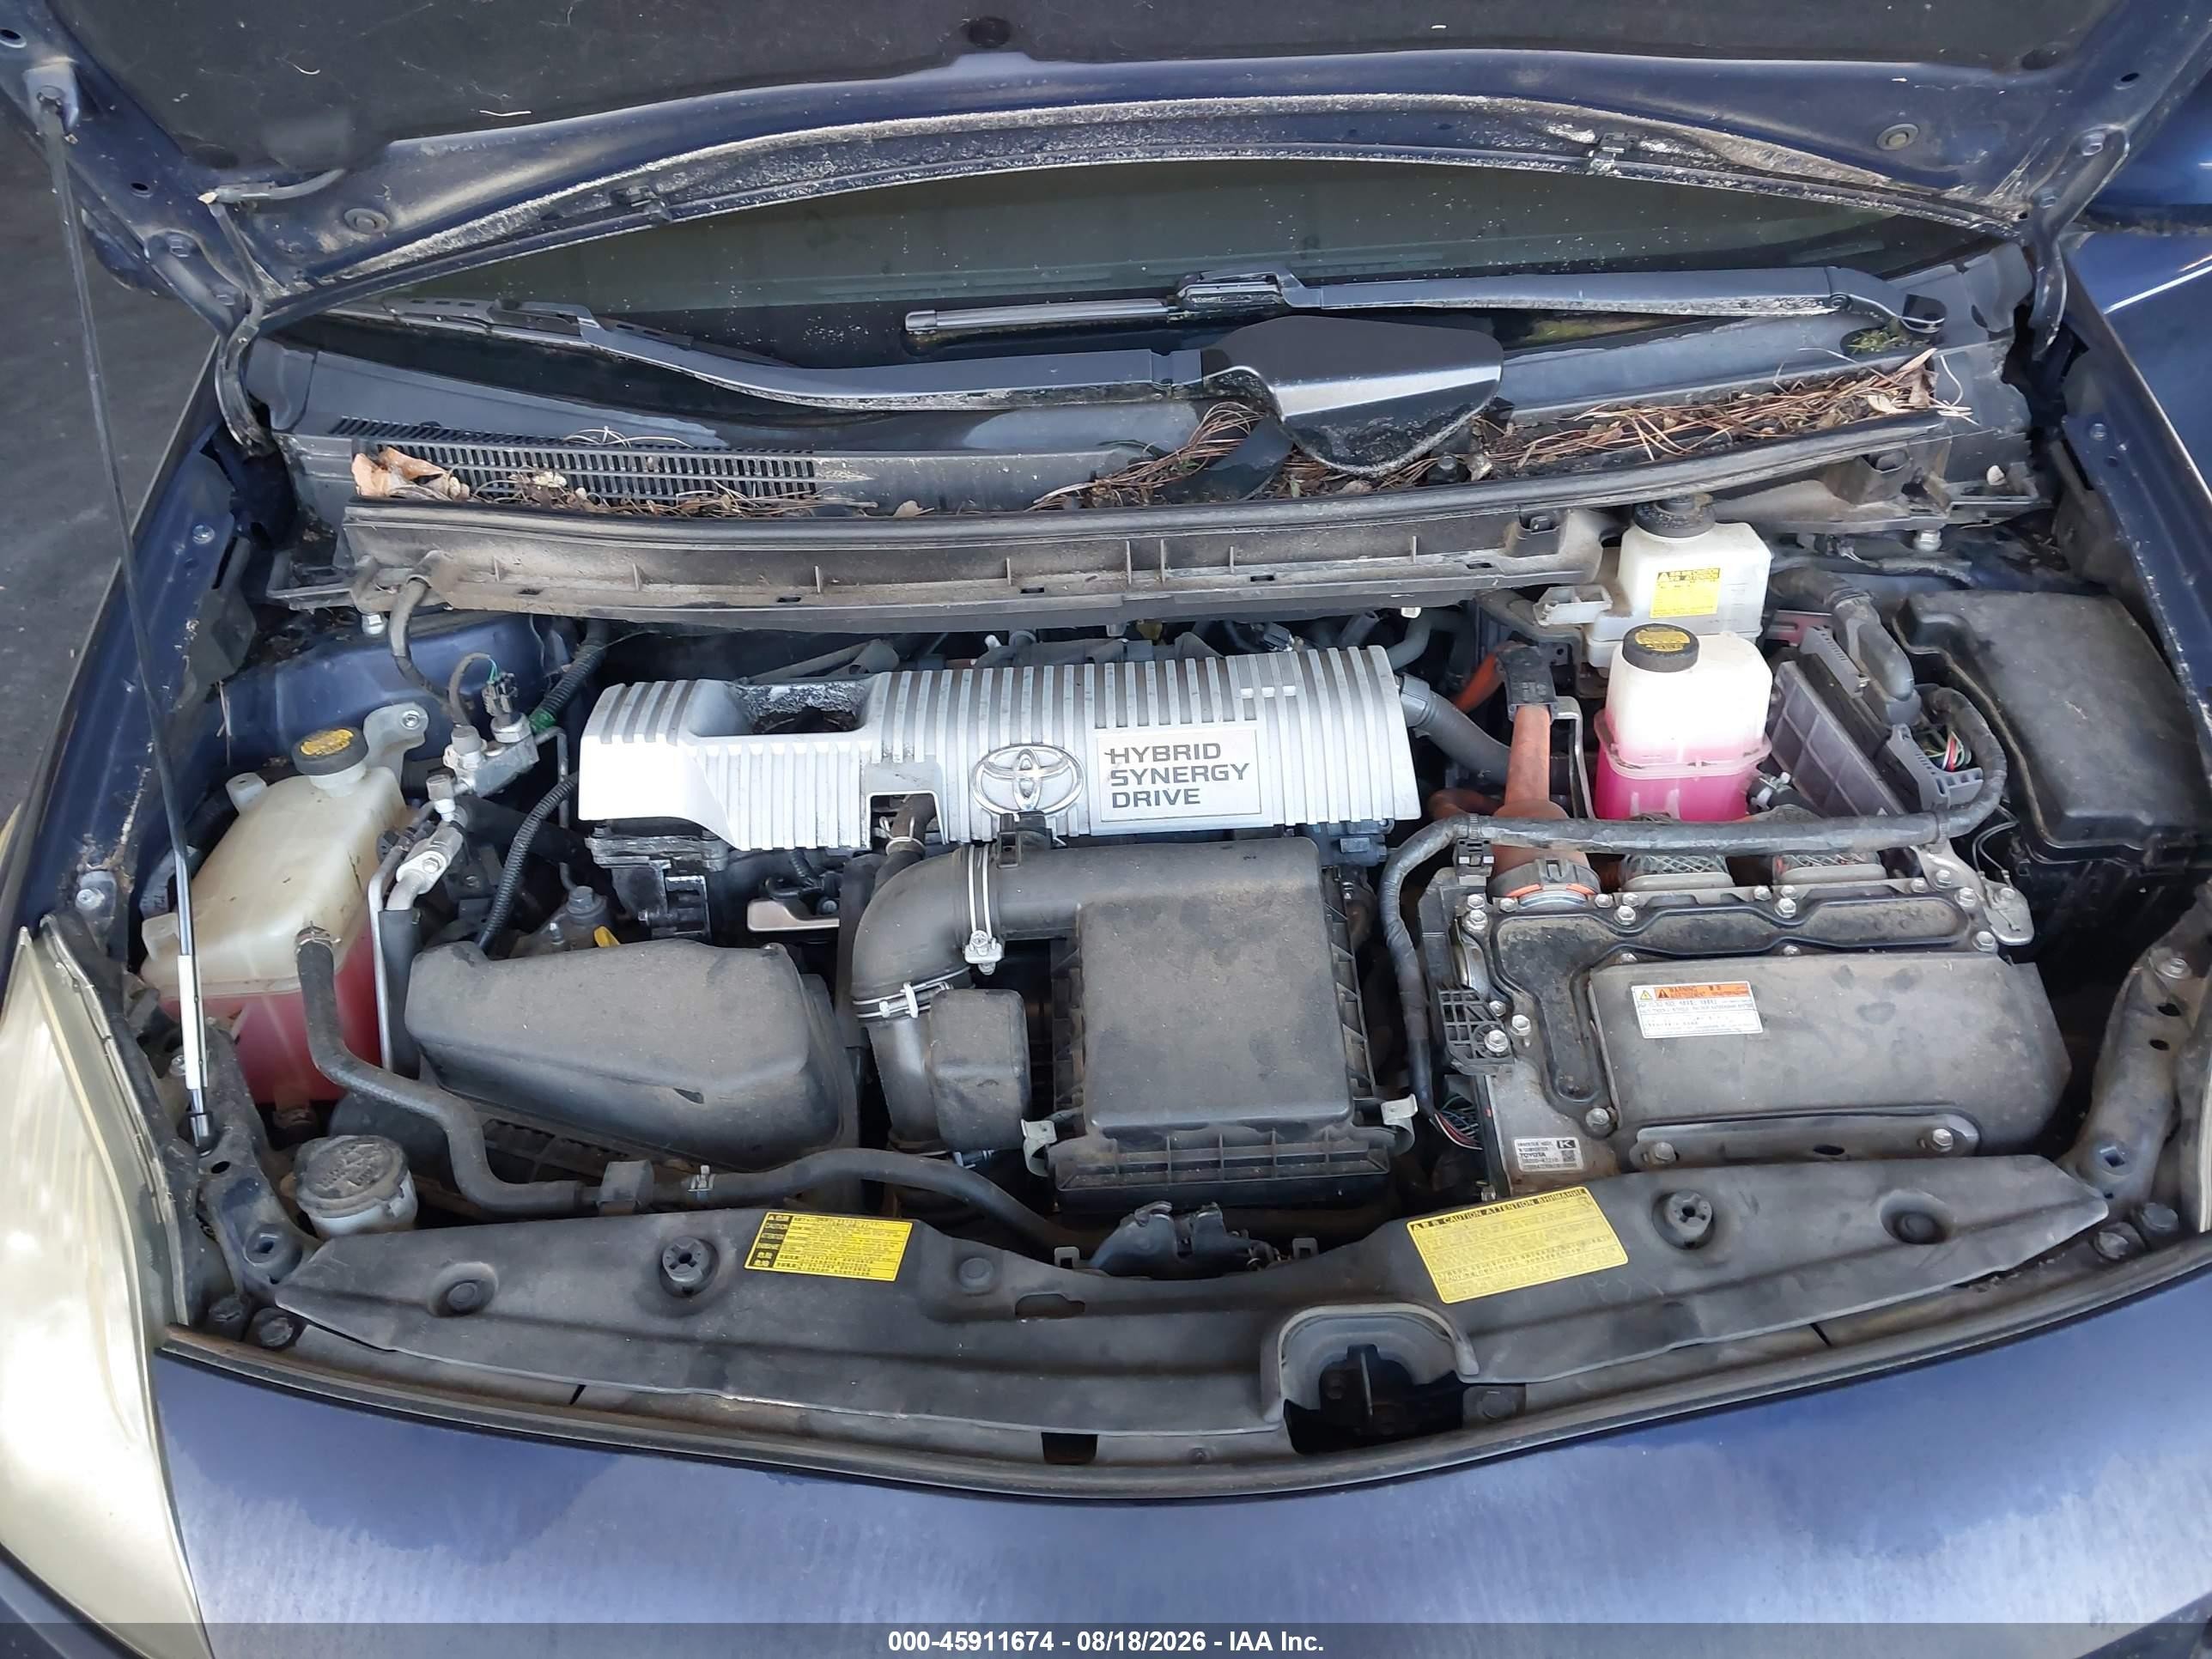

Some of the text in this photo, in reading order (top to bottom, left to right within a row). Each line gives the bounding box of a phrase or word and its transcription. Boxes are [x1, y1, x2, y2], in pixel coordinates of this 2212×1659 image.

[1109, 743, 1221, 764] HYBRID
[1110, 763, 1249, 787] SYNERGY
[1111, 788, 1201, 809] DRIVE
[1559, 1139, 1573, 1148] K
[1443, 1210, 1483, 1224] CAUTION
[1486, 1199, 1534, 1215] ATTENTION
